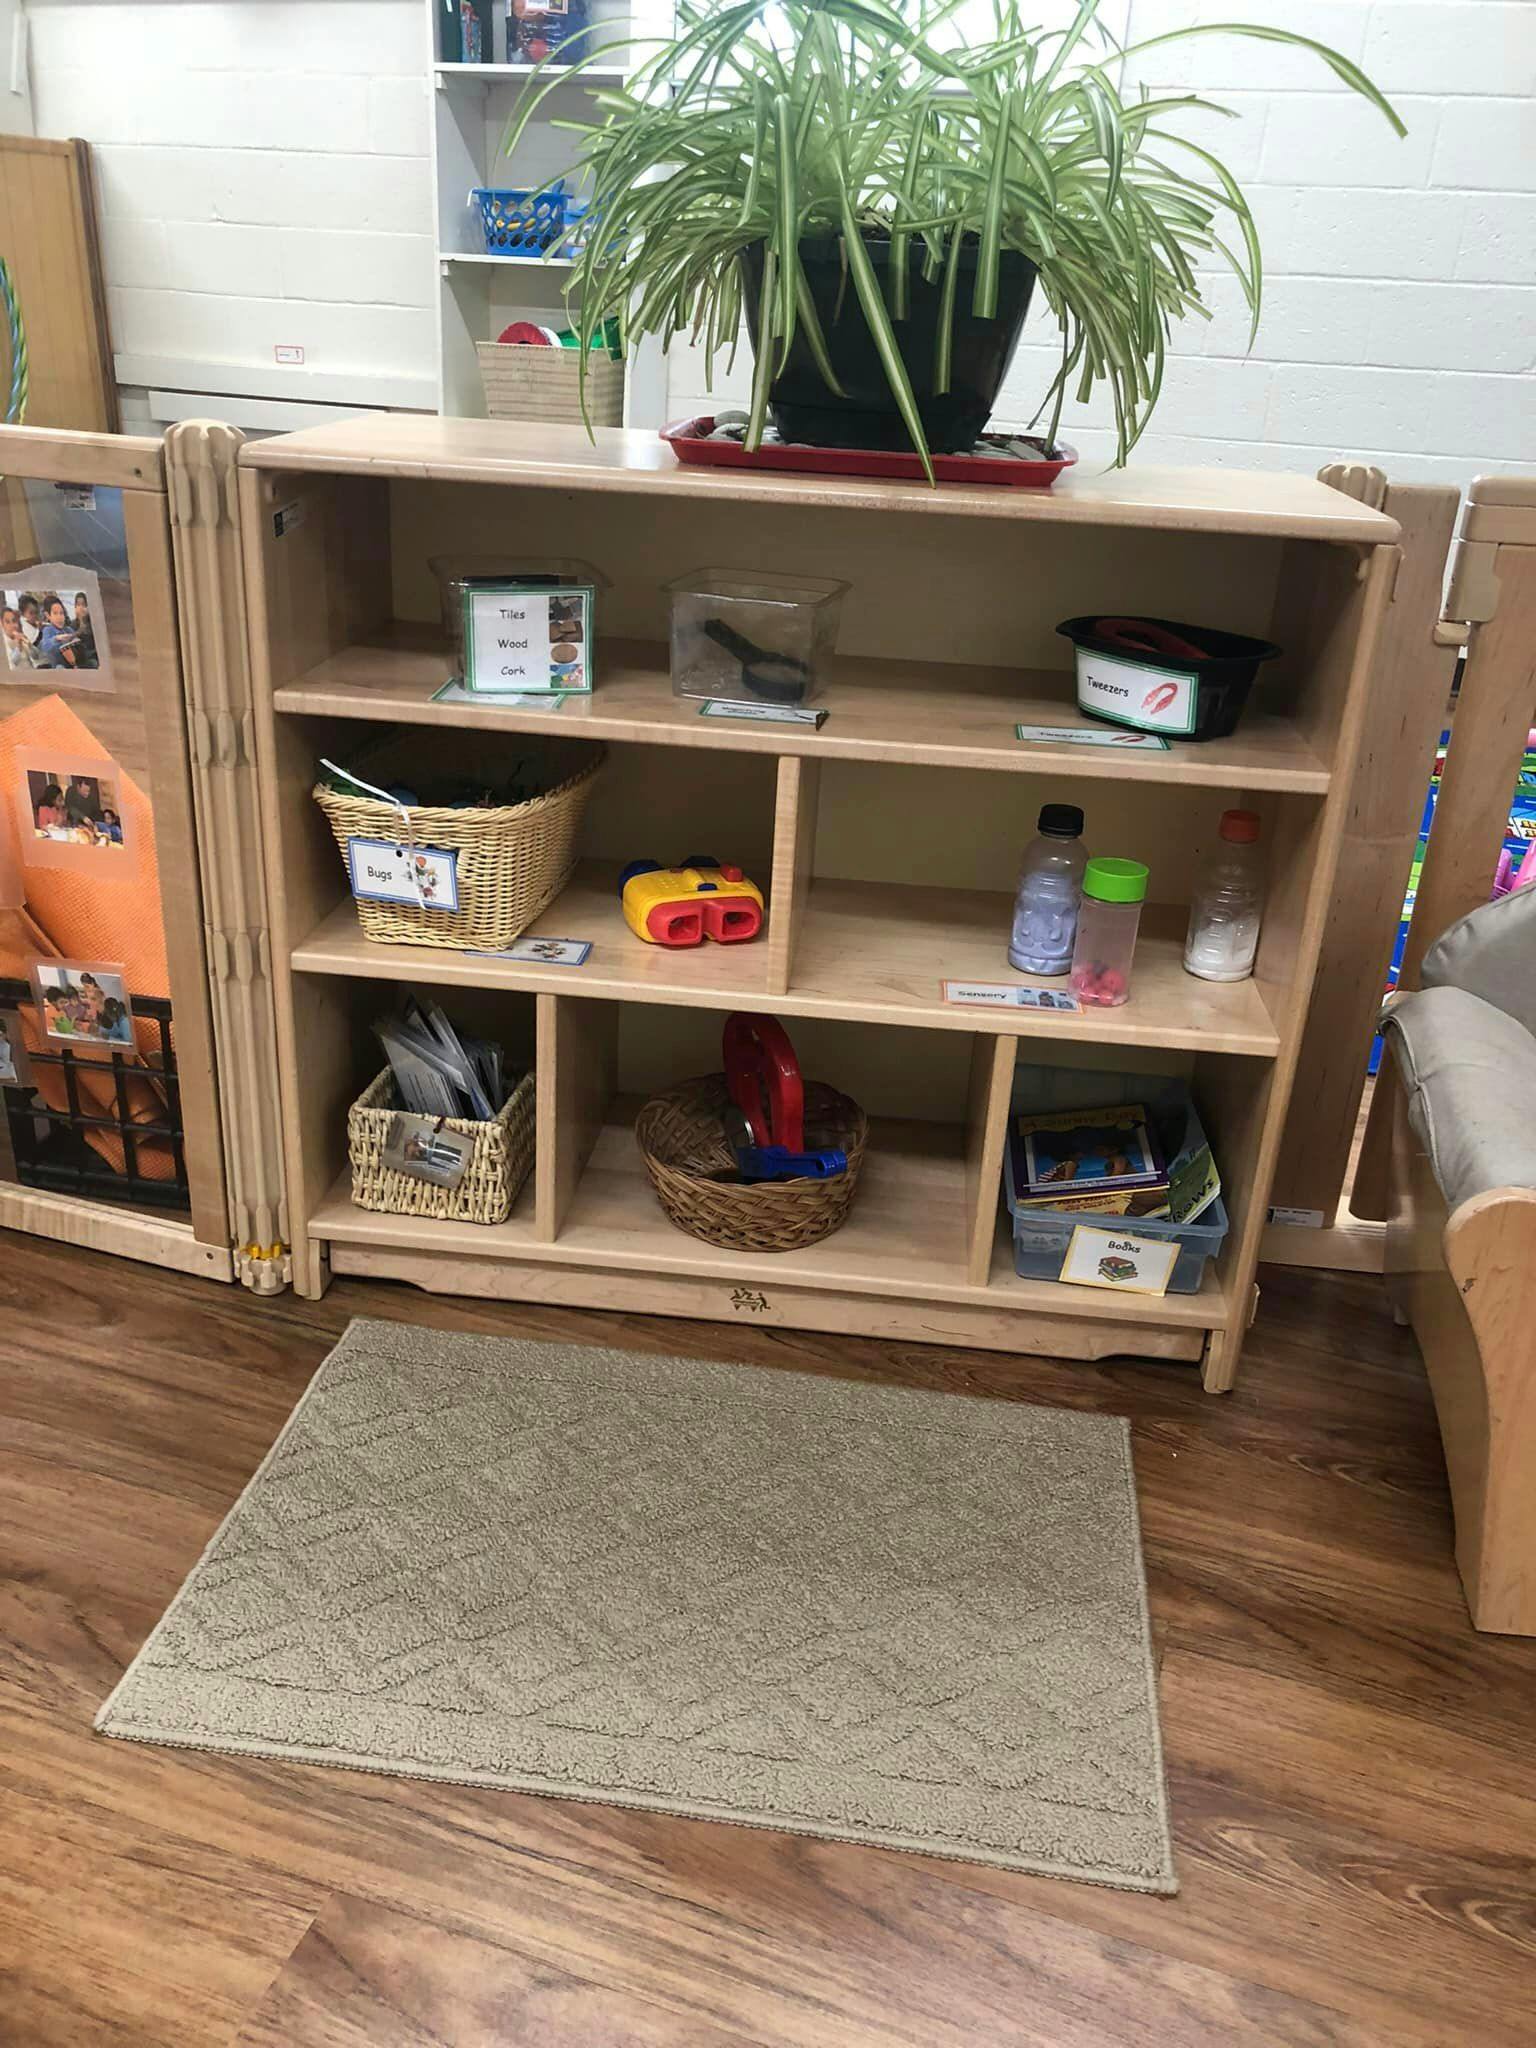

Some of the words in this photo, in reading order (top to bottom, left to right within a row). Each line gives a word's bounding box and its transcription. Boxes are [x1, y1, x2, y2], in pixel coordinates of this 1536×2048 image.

[499, 608, 526, 620] Tiles
[497, 639, 528, 649] Wood
[501, 666, 526, 676] Cork
[1086, 675, 1130, 698] Tweezers
[367, 865, 393, 882] Bugs
[957, 991, 1007, 1000] Sensory
